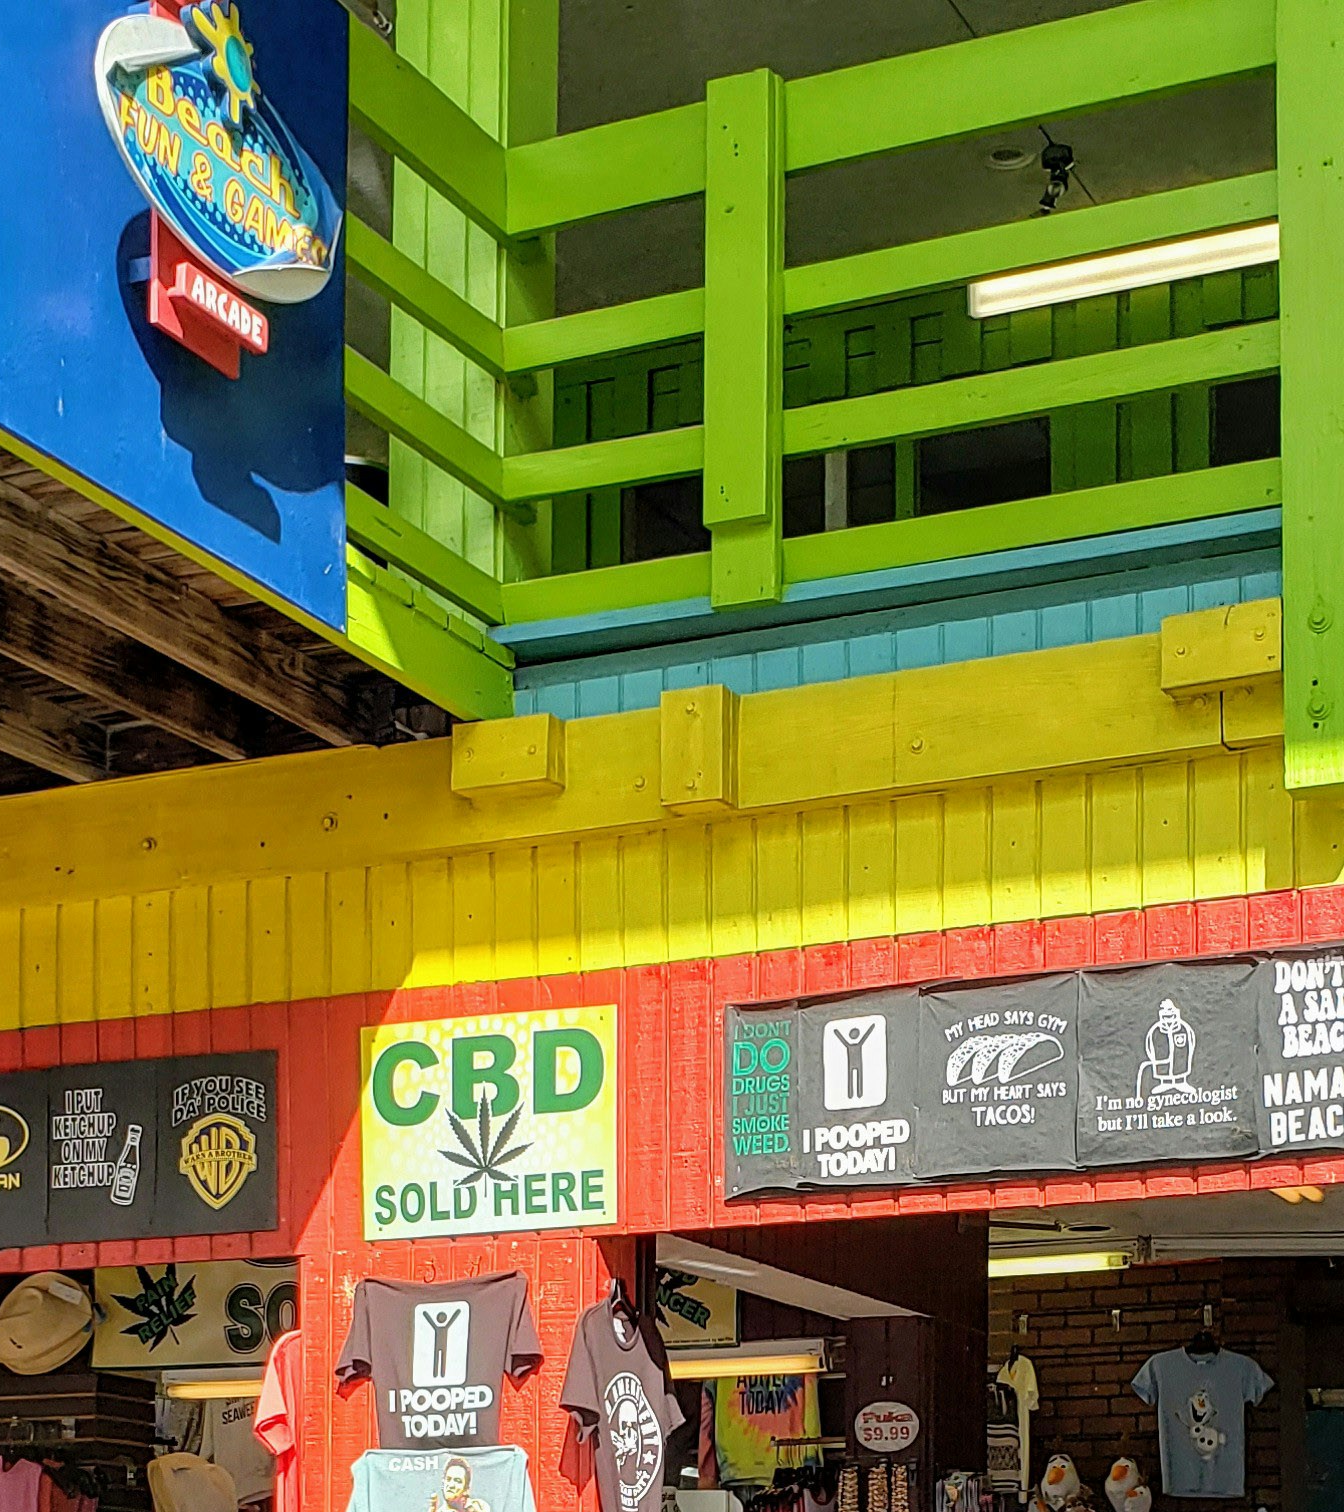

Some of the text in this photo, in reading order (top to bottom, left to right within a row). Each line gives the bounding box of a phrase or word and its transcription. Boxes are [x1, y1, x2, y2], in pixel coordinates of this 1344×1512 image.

[119, 93, 182, 176] FUN
[191, 151, 213, 204] &
[146, 65, 301, 219] Beach
[192, 276, 263, 346] ARCADE
[1274, 953, 1344, 994] DON'T
[1278, 992, 1298, 1025] A
[743, 1019, 792, 1040] DON'T
[944, 1010, 1068, 1042] MY HEAD SAYS GYM
[732, 1038, 791, 1077] DO
[371, 1027, 606, 1127] CBD
[732, 1074, 790, 1096] DRUGS
[74, 1088, 104, 1113] PUT
[173, 1076, 265, 1108] IF YOU SEE
[744, 1092, 790, 1116] JUST
[942, 1082, 1067, 1104] BUT MY HEART SAYS
[1095, 1085, 1238, 1112] I'm gynecologist
[205, 1093, 267, 1122] POLICE
[971, 1104, 1036, 1127] TACOS!
[1097, 1106, 1237, 1132] but take look.
[52, 1112, 117, 1141] KETCHUP
[732, 1115, 790, 1135] SMOKE
[803, 1119, 910, 1153] I POOPED
[61, 1138, 107, 1163] ON MY
[732, 1134, 792, 1156] WEED.
[51, 1161, 115, 1189] KETCHUP
[375, 1170, 606, 1226] SOLD HERE
[136, 1287, 197, 1345] RELIEF
[388, 1384, 492, 1413] I POOPED
[739, 1391, 783, 1415] TODAY
[402, 1410, 477, 1438] TODAY!
[862, 1411, 914, 1424] Puka
[863, 1425, 910, 1442] $9.99
[388, 1455, 439, 1473] CASH
